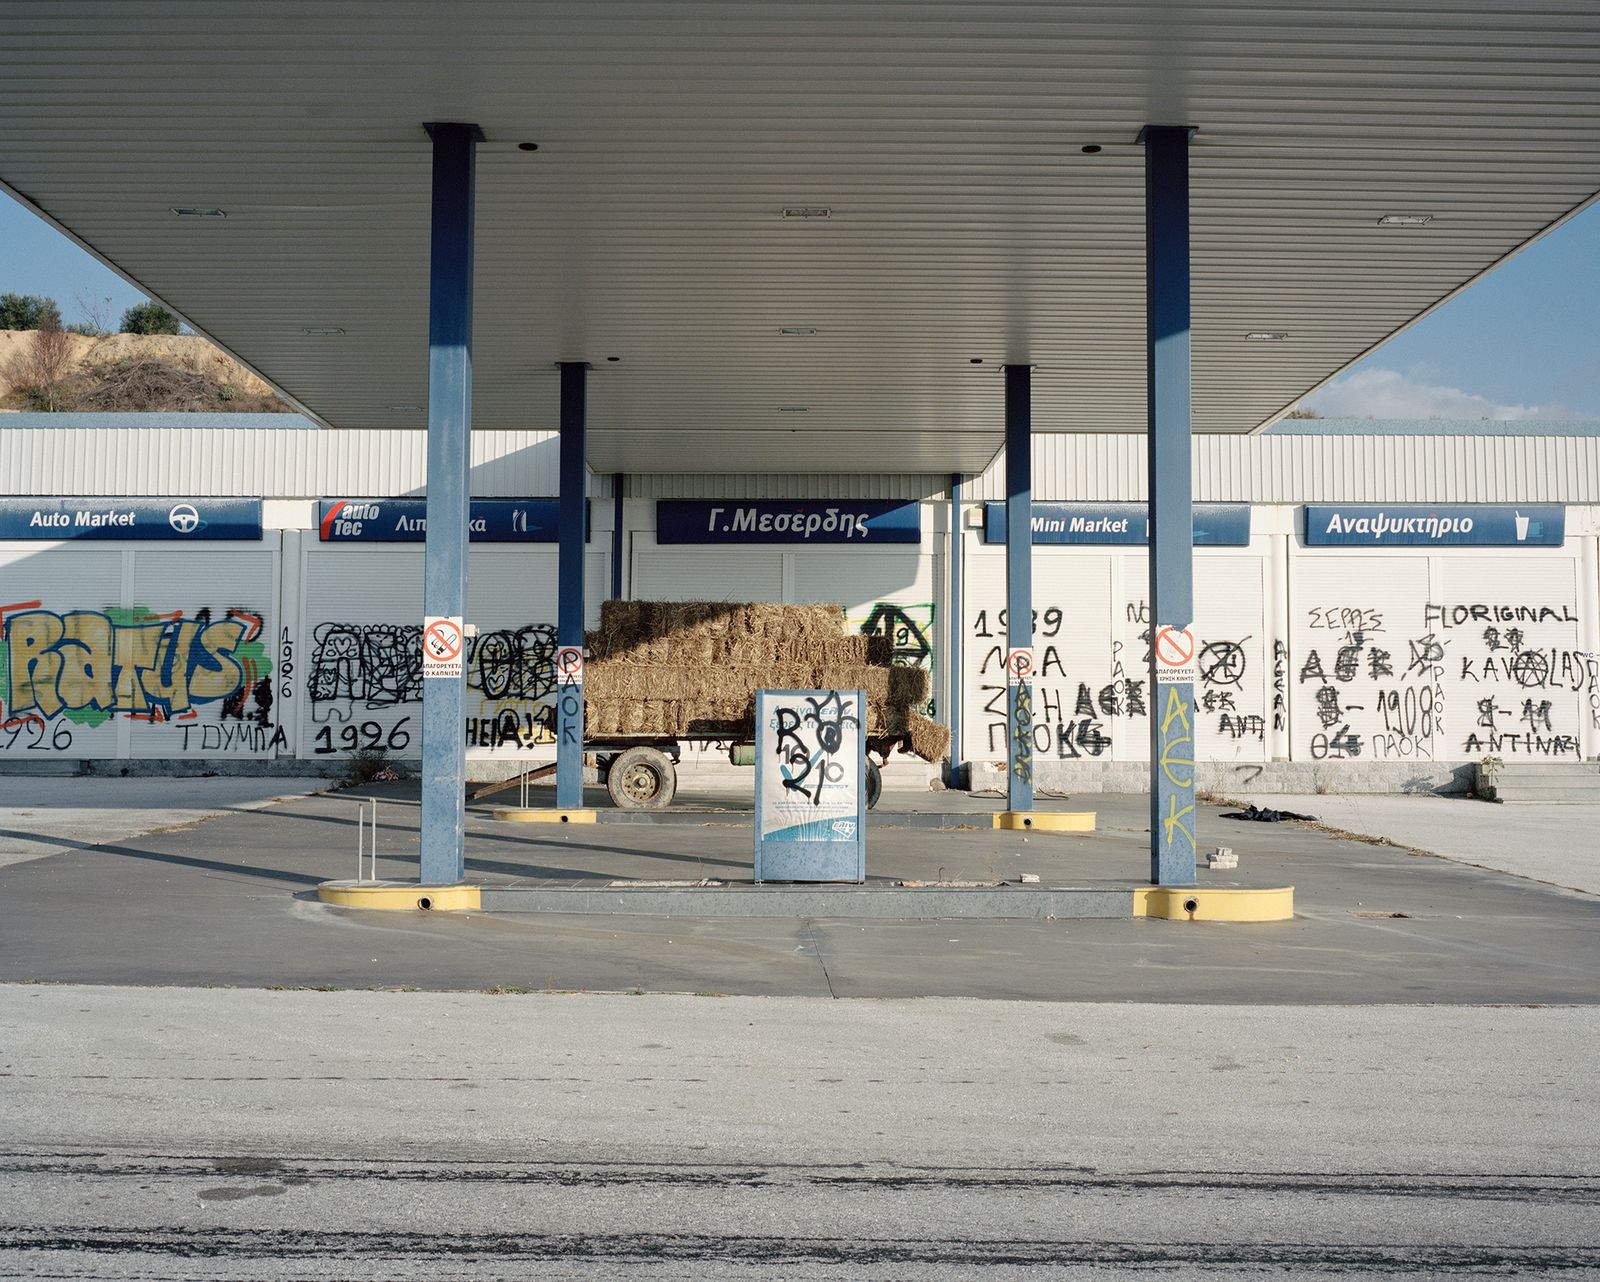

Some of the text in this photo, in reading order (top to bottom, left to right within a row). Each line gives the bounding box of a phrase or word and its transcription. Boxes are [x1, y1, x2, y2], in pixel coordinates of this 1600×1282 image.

[30, 510, 136, 527] Auto Market
[342, 505, 380, 520] auto
[334, 519, 363, 536] Tec
[1031, 517, 1129, 533] Mini Market
[1326, 512, 1473, 539] Αναψυκτήριο
[0, 716, 73, 750] 926
[315, 716, 411, 753] 1926
